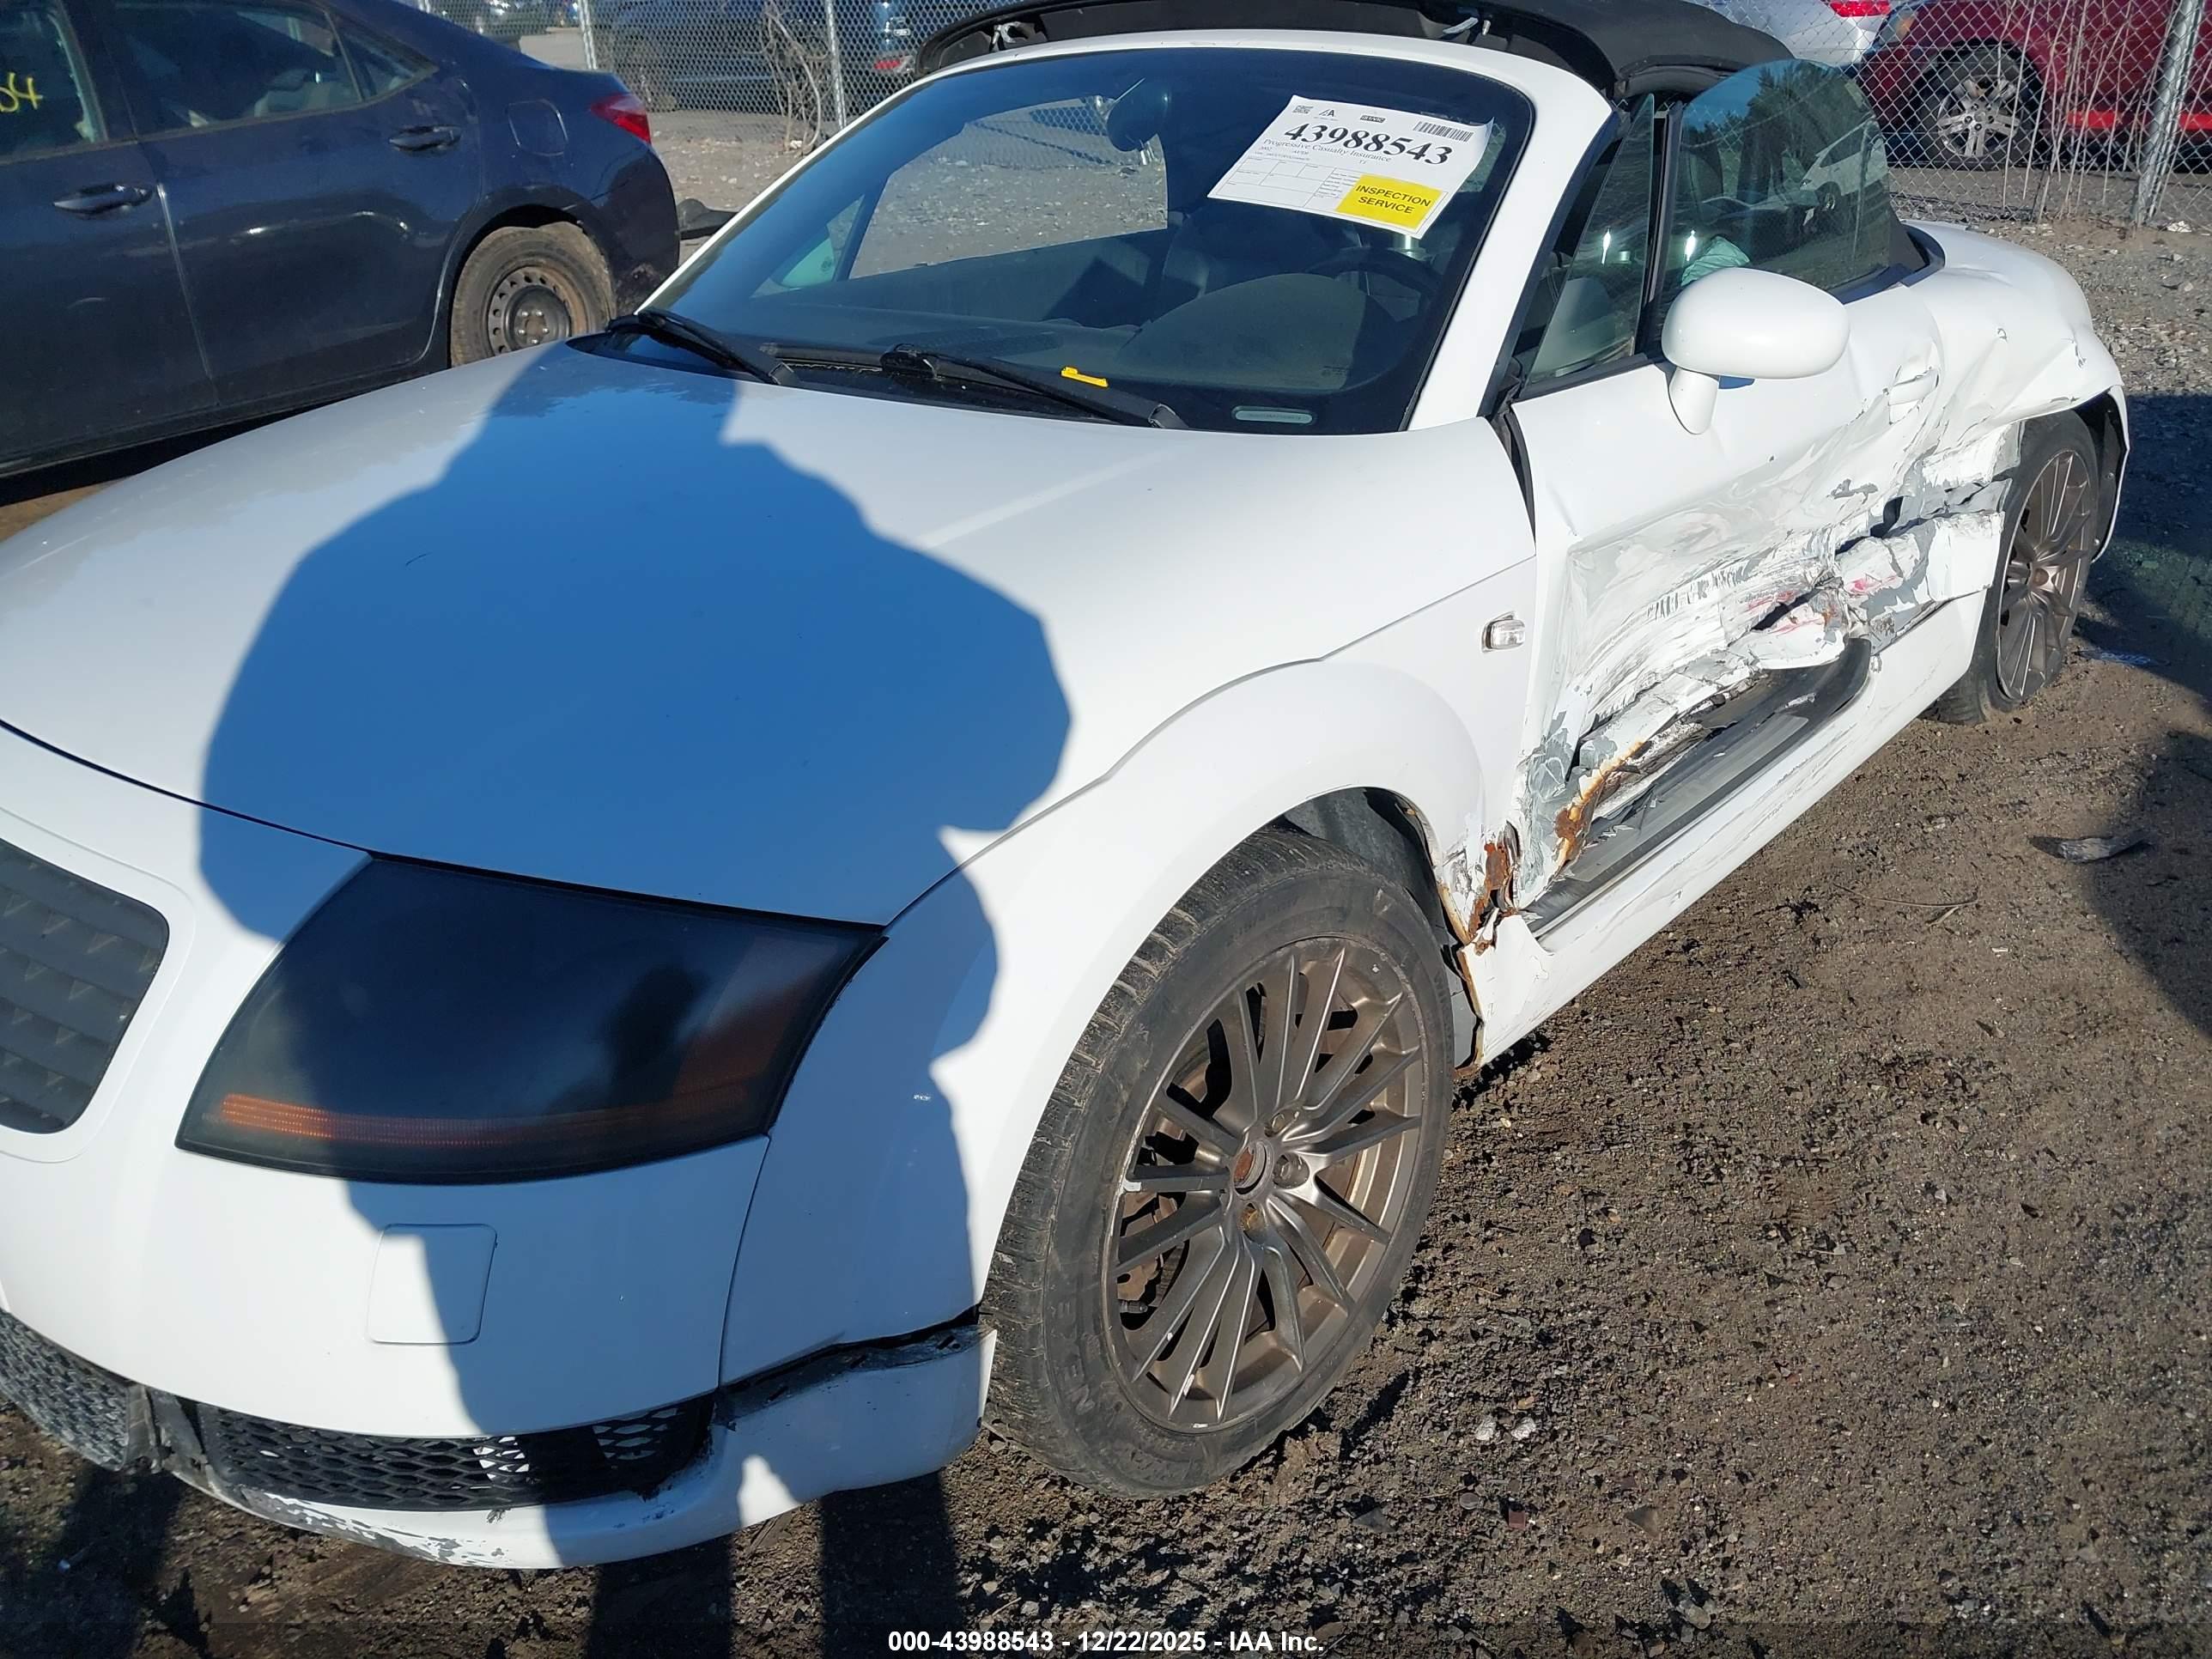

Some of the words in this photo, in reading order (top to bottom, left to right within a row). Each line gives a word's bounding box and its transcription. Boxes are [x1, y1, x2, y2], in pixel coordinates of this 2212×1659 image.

[1263, 138, 1311, 149] Progressive
[1312, 144, 1349, 155] Casualty
[1350, 150, 1392, 162] Insurance
[1284, 123, 1453, 165] 43988543
[1356, 185, 1431, 207] INSPECTION
[1358, 196, 1415, 214] SERVICE
